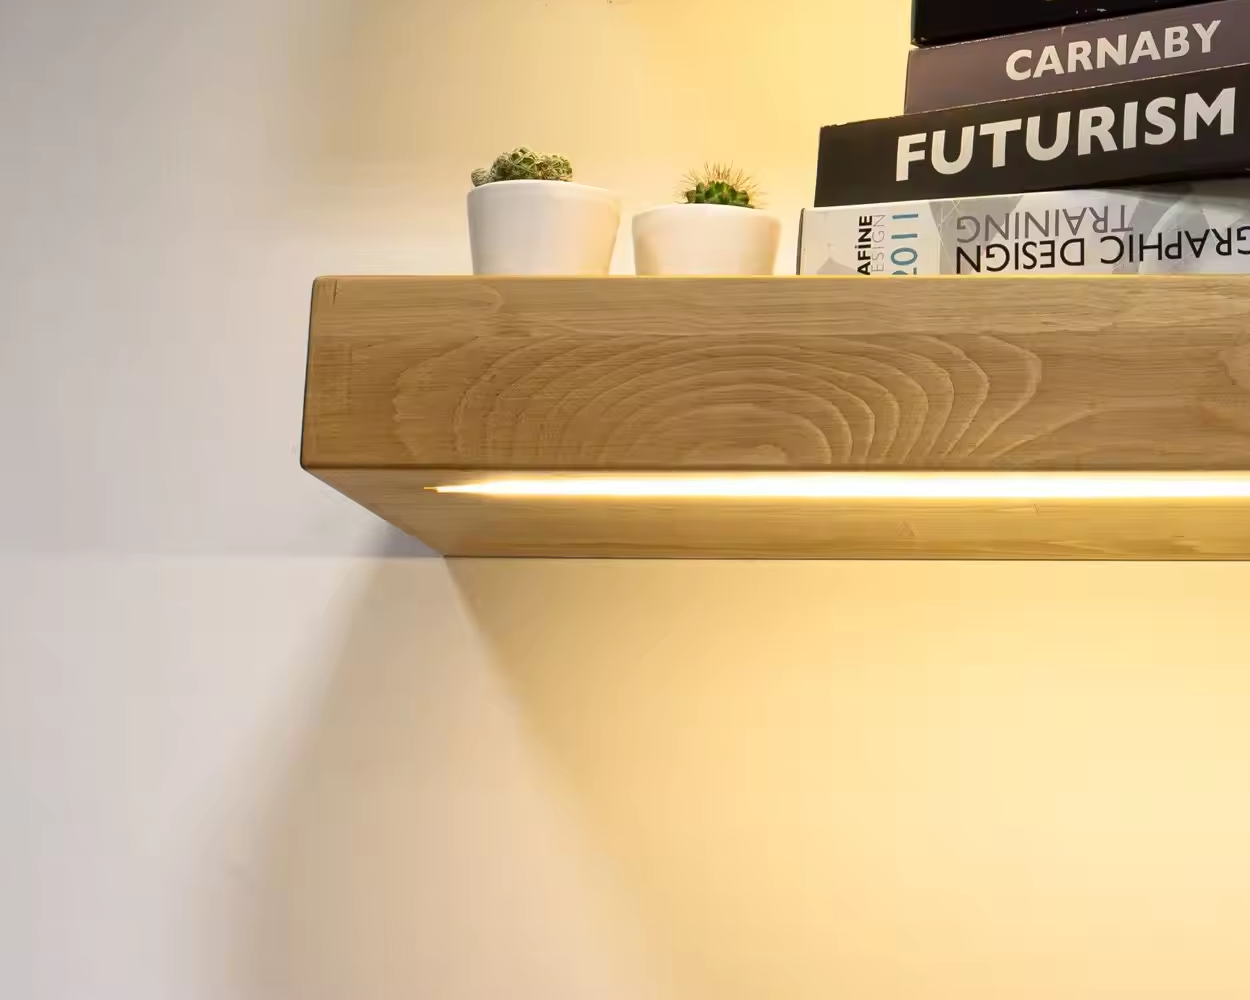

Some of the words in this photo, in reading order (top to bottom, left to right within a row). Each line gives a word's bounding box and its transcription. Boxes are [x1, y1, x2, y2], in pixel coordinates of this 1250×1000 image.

[1005, 19, 1222, 81] CARNABY
[895, 87, 1236, 182] FUTURISM
[956, 204, 1133, 243] TRAINING
[956, 237, 1085, 274] DESIGN
